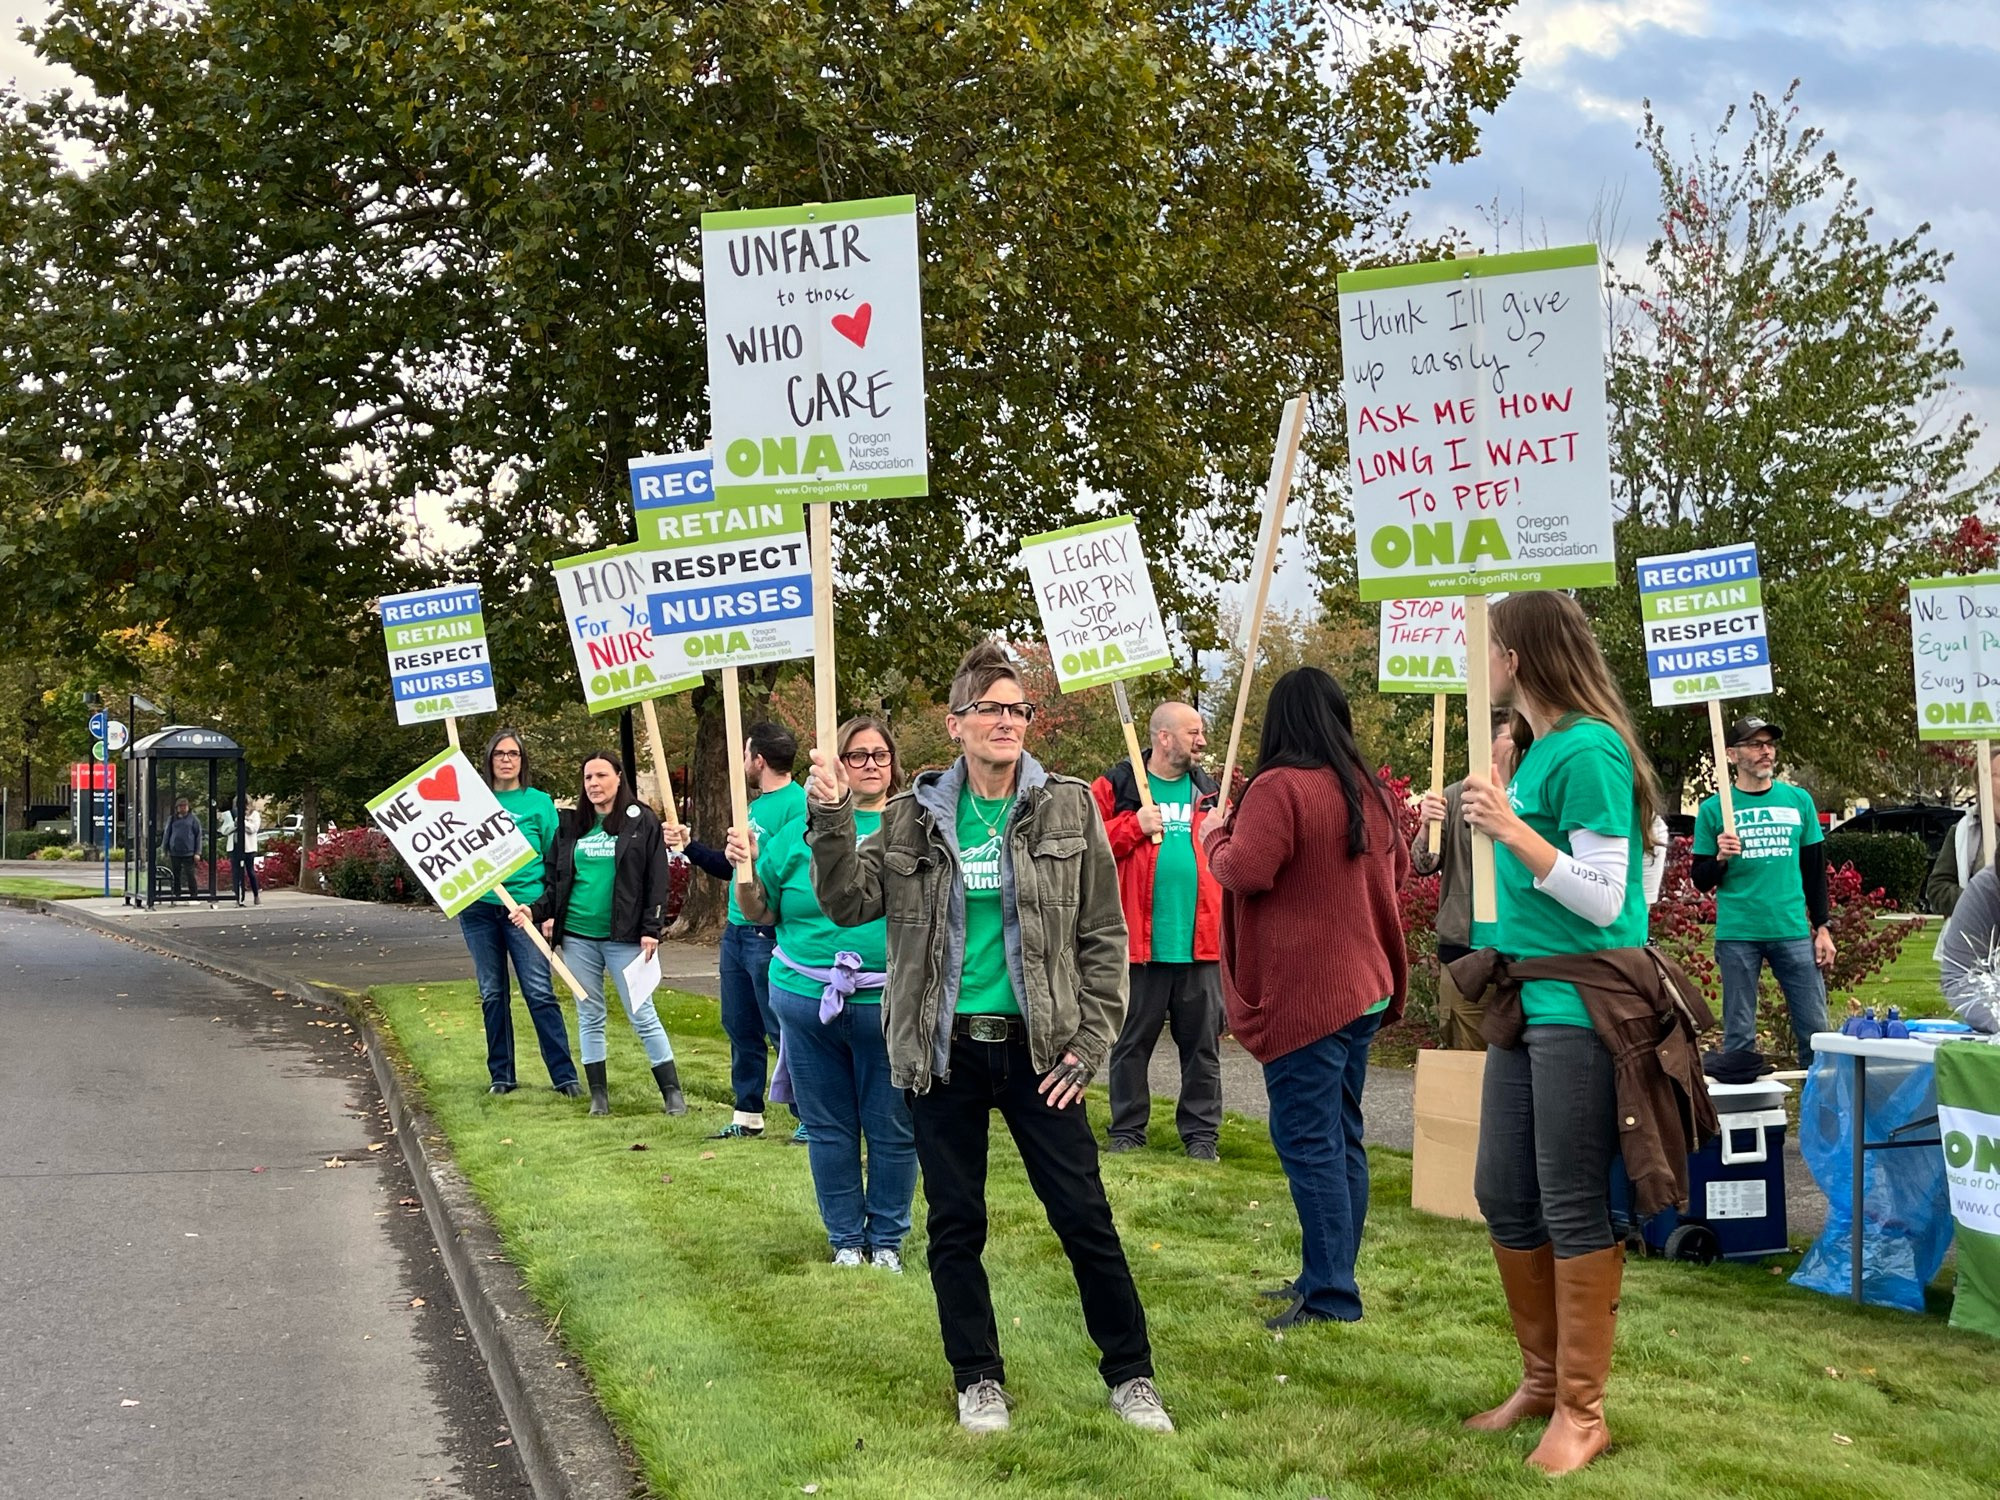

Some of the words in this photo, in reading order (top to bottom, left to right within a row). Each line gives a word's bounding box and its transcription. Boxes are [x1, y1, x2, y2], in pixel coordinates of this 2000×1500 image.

[728, 224, 870, 277] UNFAIR
[777, 289, 795, 306] to
[805, 286, 855, 304] those
[1350, 299, 1428, 341] think
[1503, 290, 1570, 342] give
[726, 324, 803, 366] WHO
[1352, 361, 1384, 392] up
[787, 370, 894, 427] CARE
[1358, 403, 1419, 435] ASK
[1434, 398, 1475, 424] ME
[1500, 387, 1573, 418] HOW
[848, 431, 891, 446] Oregon
[849, 445, 889, 458] Nurses
[725, 434, 845, 477] ONA
[849, 457, 914, 471] Association
[1357, 446, 1433, 484] LONG
[1444, 438, 1471, 471] I
[1487, 432, 1579, 466] WAIT
[639, 468, 715, 501] REC
[775, 482, 868, 496] www.OregonRN.org
[1399, 488, 1437, 518] TO
[1453, 477, 1521, 510] PEE!
[657, 503, 784, 540] RETAIN
[1516, 515, 1569, 530] Oregon
[1371, 518, 1512, 568] ONA
[1517, 530, 1568, 544] Nurses
[652, 543, 802, 583] RESPECT
[1048, 532, 1128, 575] LEGACY
[1518, 543, 1598, 559] Association
[1428, 572, 1541, 588] www.OregonRN.org
[1643, 556, 1752, 587] RECRUIT
[1043, 579, 1094, 612] FAIR
[1091, 570, 1137, 600] PAY
[1656, 586, 1747, 614] RETAIN
[385, 595, 475, 622] RECRUIT
[662, 586, 802, 625] NURSES
[1071, 601, 1117, 628] STOP
[1389, 600, 1444, 620] STOP
[1914, 595, 1948, 622] We
[396, 621, 472, 645] RETAIN
[575, 615, 611, 640] For
[752, 628, 776, 636] Oregon
[753, 635, 776, 643] Nurses
[1056, 629, 1090, 648] The
[1387, 623, 1450, 645] THEFT
[1651, 615, 1759, 644] RESPECT
[684, 631, 751, 657] ONA
[754, 640, 791, 650] Association
[1124, 637, 1149, 647] Oregon
[1128, 648, 1163, 661] Association
[1918, 632, 1967, 662] Equal
[394, 645, 483, 670] RESPECT
[1061, 643, 1127, 675] ONA
[1387, 655, 1457, 678] ONA
[1657, 644, 1759, 672] NURSES
[400, 669, 485, 695] NURSES
[590, 664, 657, 696] ONA
[1673, 675, 1722, 695] ONA
[414, 696, 454, 714] ONA
[1925, 701, 1994, 725] ONA
[375, 791, 422, 832] WE
[412, 811, 467, 853] OUR
[1739, 826, 1793, 838] RECRUIT
[1745, 837, 1790, 848] RETAIN
[418, 810, 515, 882] PATIENTS
[1742, 847, 1793, 859] RESPECT
[439, 858, 496, 901] ONA
[1970, 1177, 1982, 1188] of
